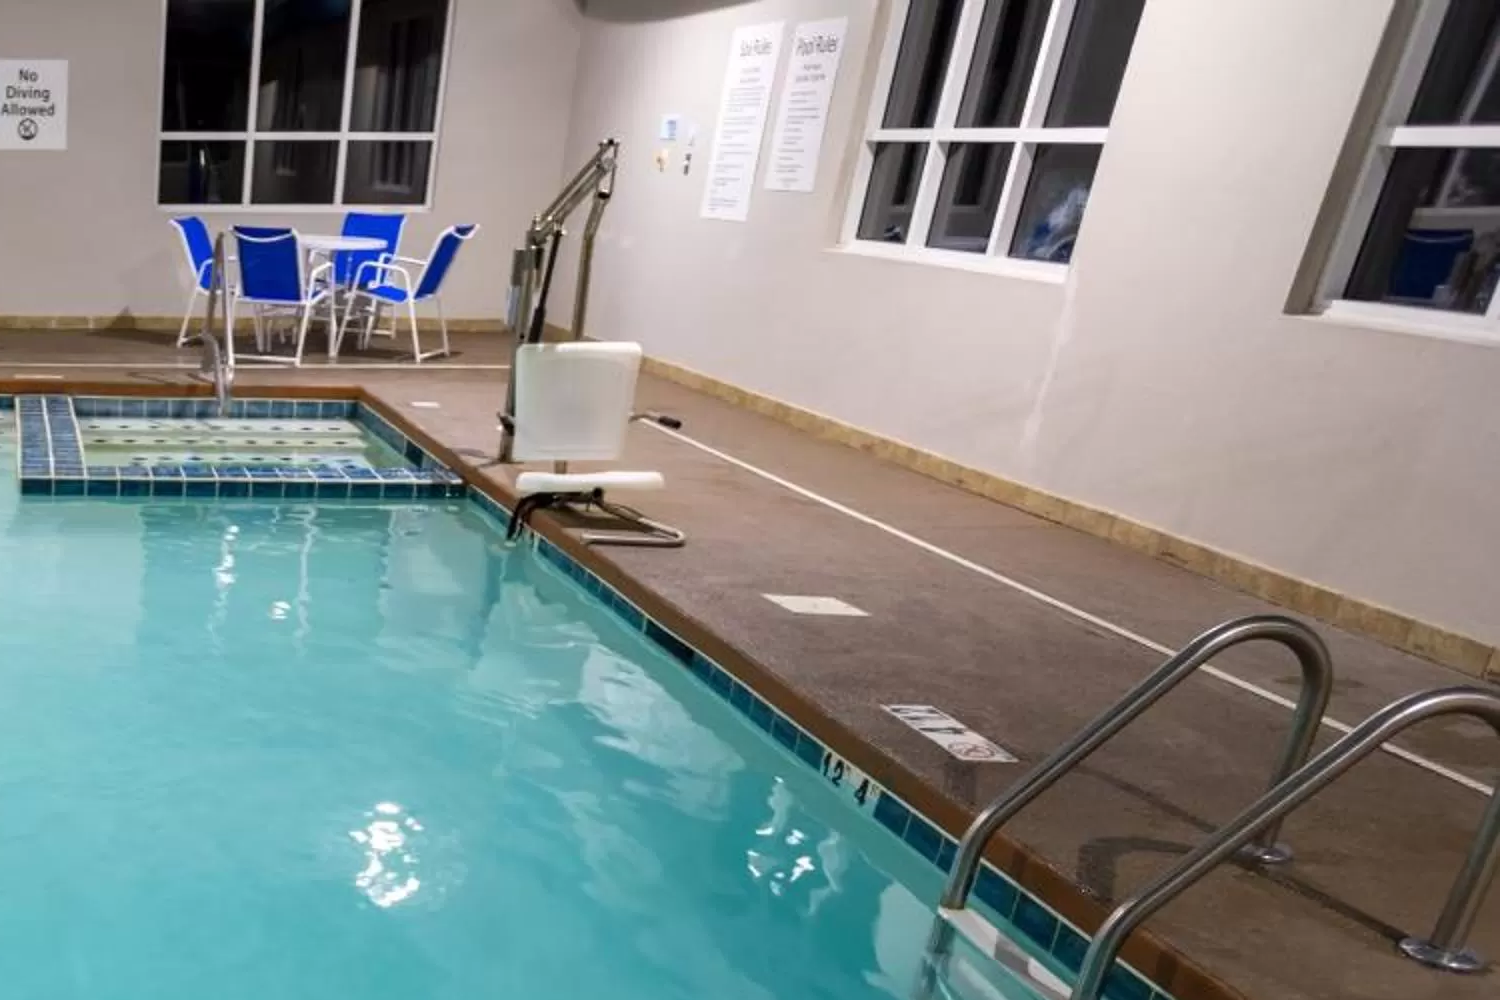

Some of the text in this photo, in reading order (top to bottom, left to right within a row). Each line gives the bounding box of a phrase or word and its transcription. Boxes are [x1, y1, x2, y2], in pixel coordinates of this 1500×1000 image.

[18, 68, 38, 82] No
[5, 84, 50, 102] Diving
[1, 103, 55, 117] Allowed
